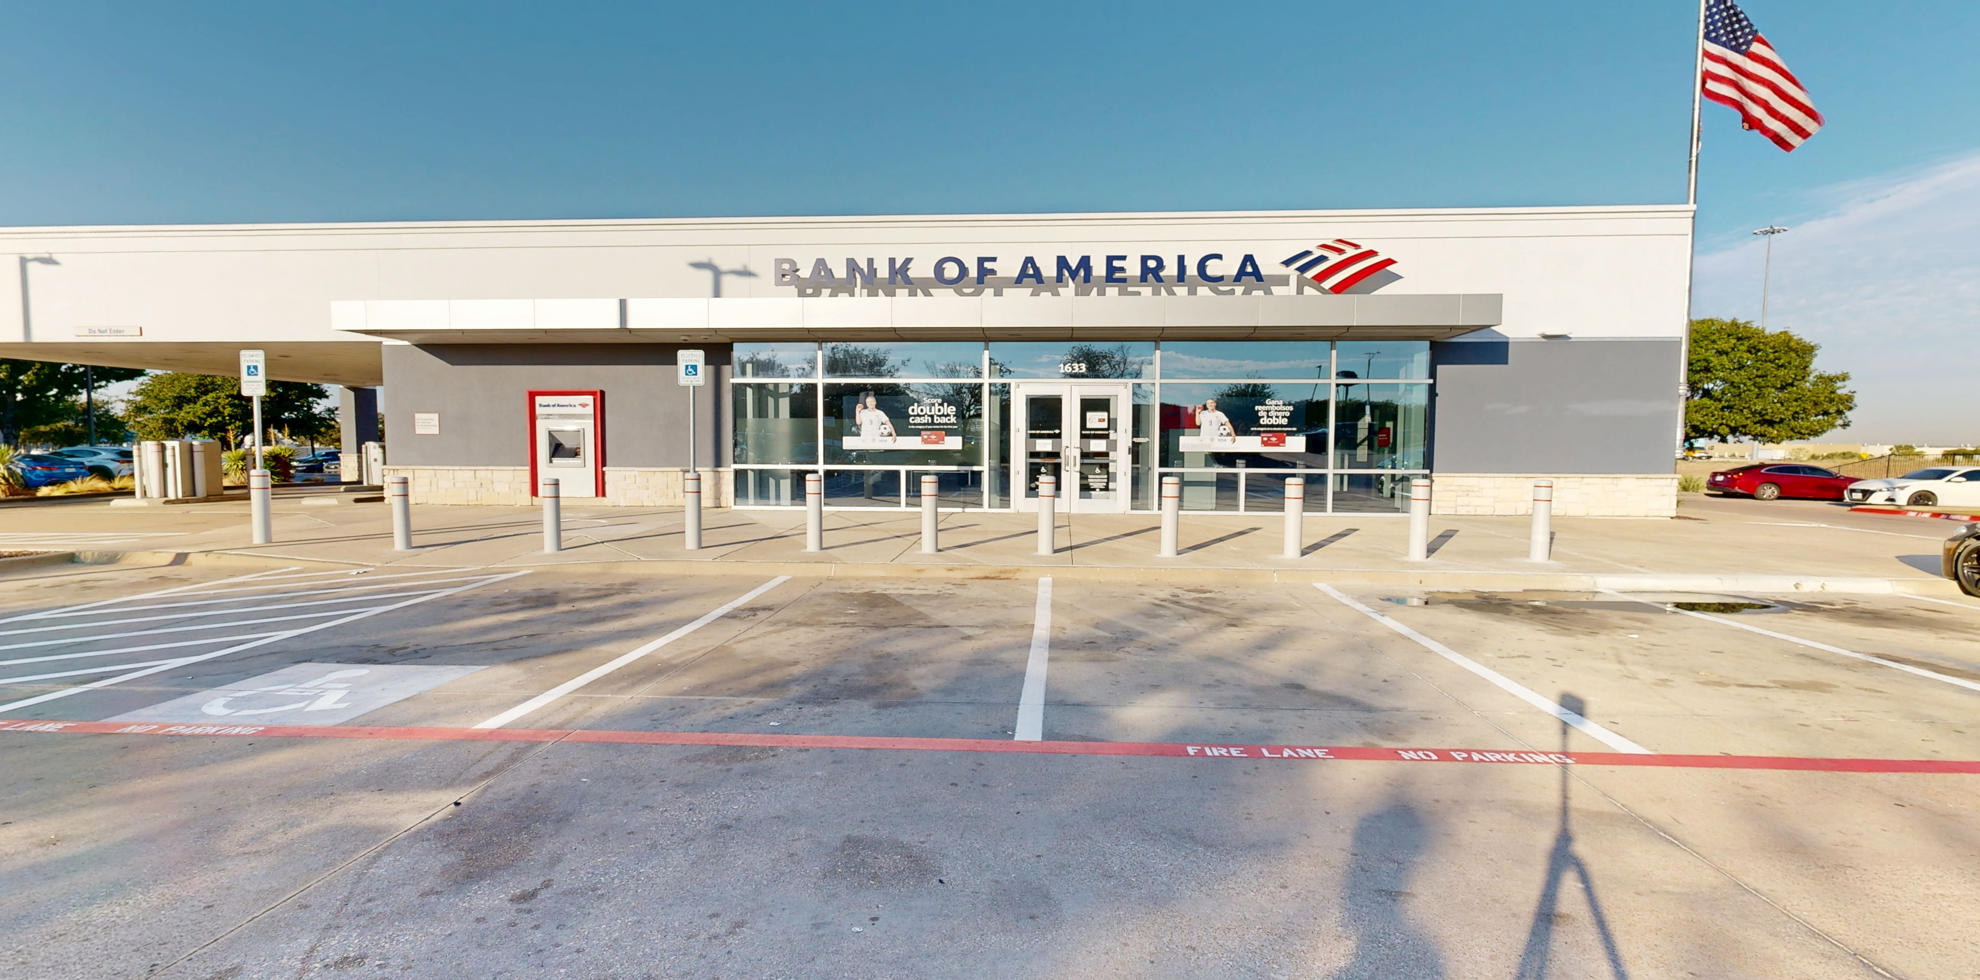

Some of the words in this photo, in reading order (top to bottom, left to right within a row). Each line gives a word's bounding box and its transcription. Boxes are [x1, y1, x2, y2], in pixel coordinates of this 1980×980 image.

[774, 257, 915, 287] BANK
[933, 256, 998, 286] OF
[1014, 253, 1265, 285] AMERICA
[1059, 363, 1087, 373] 1633
[908, 402, 957, 415] double
[908, 414, 932, 424] cash
[933, 414, 957, 424] back
[1259, 415, 1289, 425] doble
[117, 725, 160, 733] NO
[157, 725, 265, 735] PARKING
[1186, 745, 1249, 757] FIRE
[1261, 747, 1335, 759] LANE
[1397, 749, 1440, 761] NO
[1449, 750, 1577, 764] PARKING
